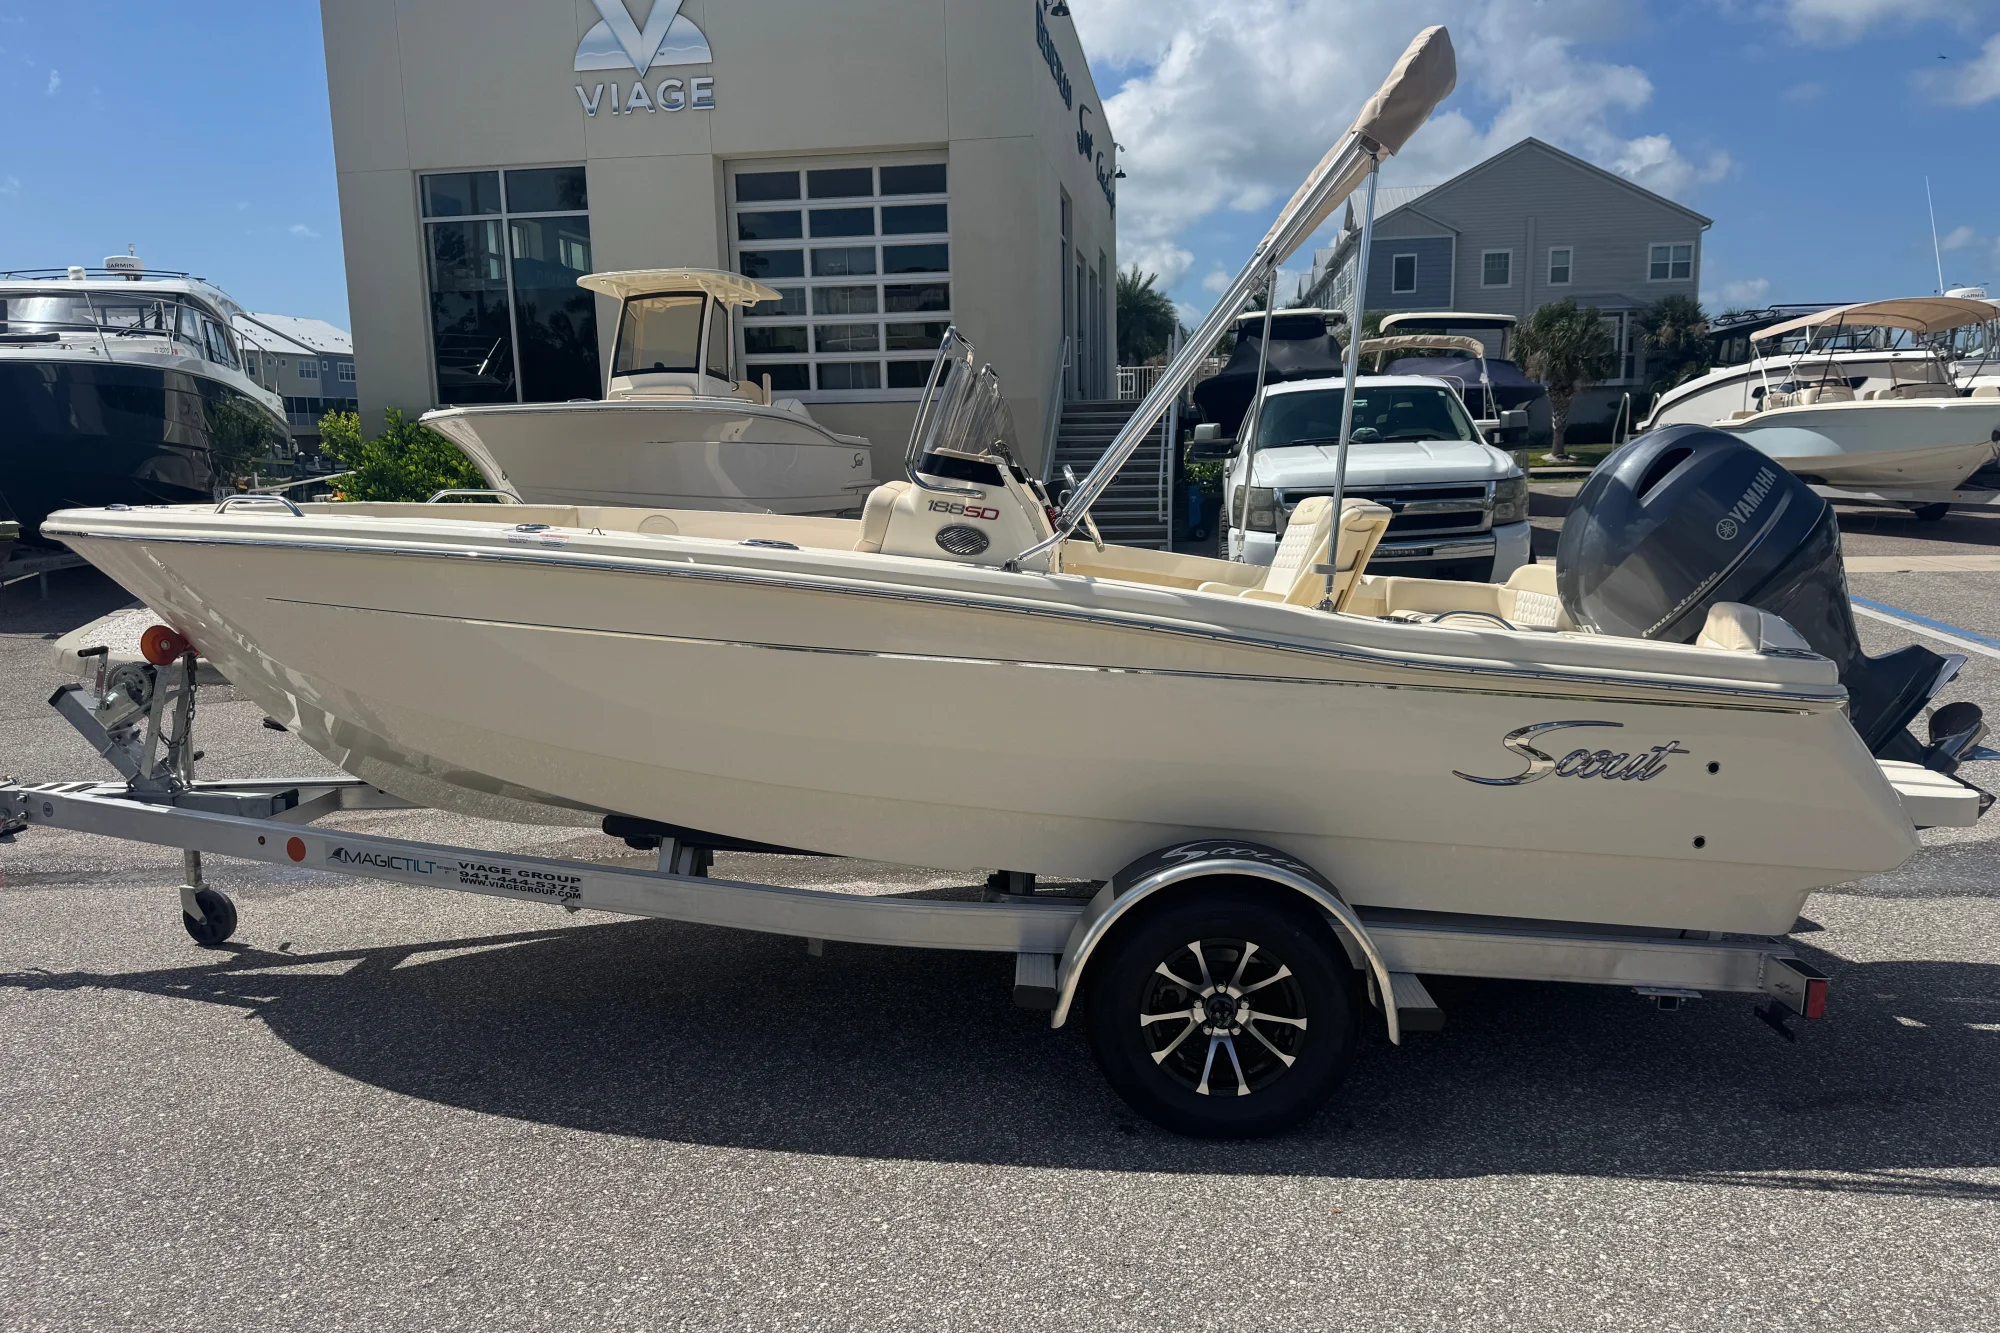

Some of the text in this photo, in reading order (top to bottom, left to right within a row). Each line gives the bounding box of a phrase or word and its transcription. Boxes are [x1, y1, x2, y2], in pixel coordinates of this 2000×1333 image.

[574, 77, 716, 117] VIAGE
[1728, 466, 1777, 524] YAMAHA
[927, 499, 1000, 521] 188SD
[1451, 720, 1690, 786] Scout
[344, 849, 437, 874] MAGICTILT
[457, 861, 582, 884] VIAGE GROUP
[458, 870, 580, 893] 941-444-5375
[459, 877, 581, 900] WWW.VIAGEGROUP.COM
